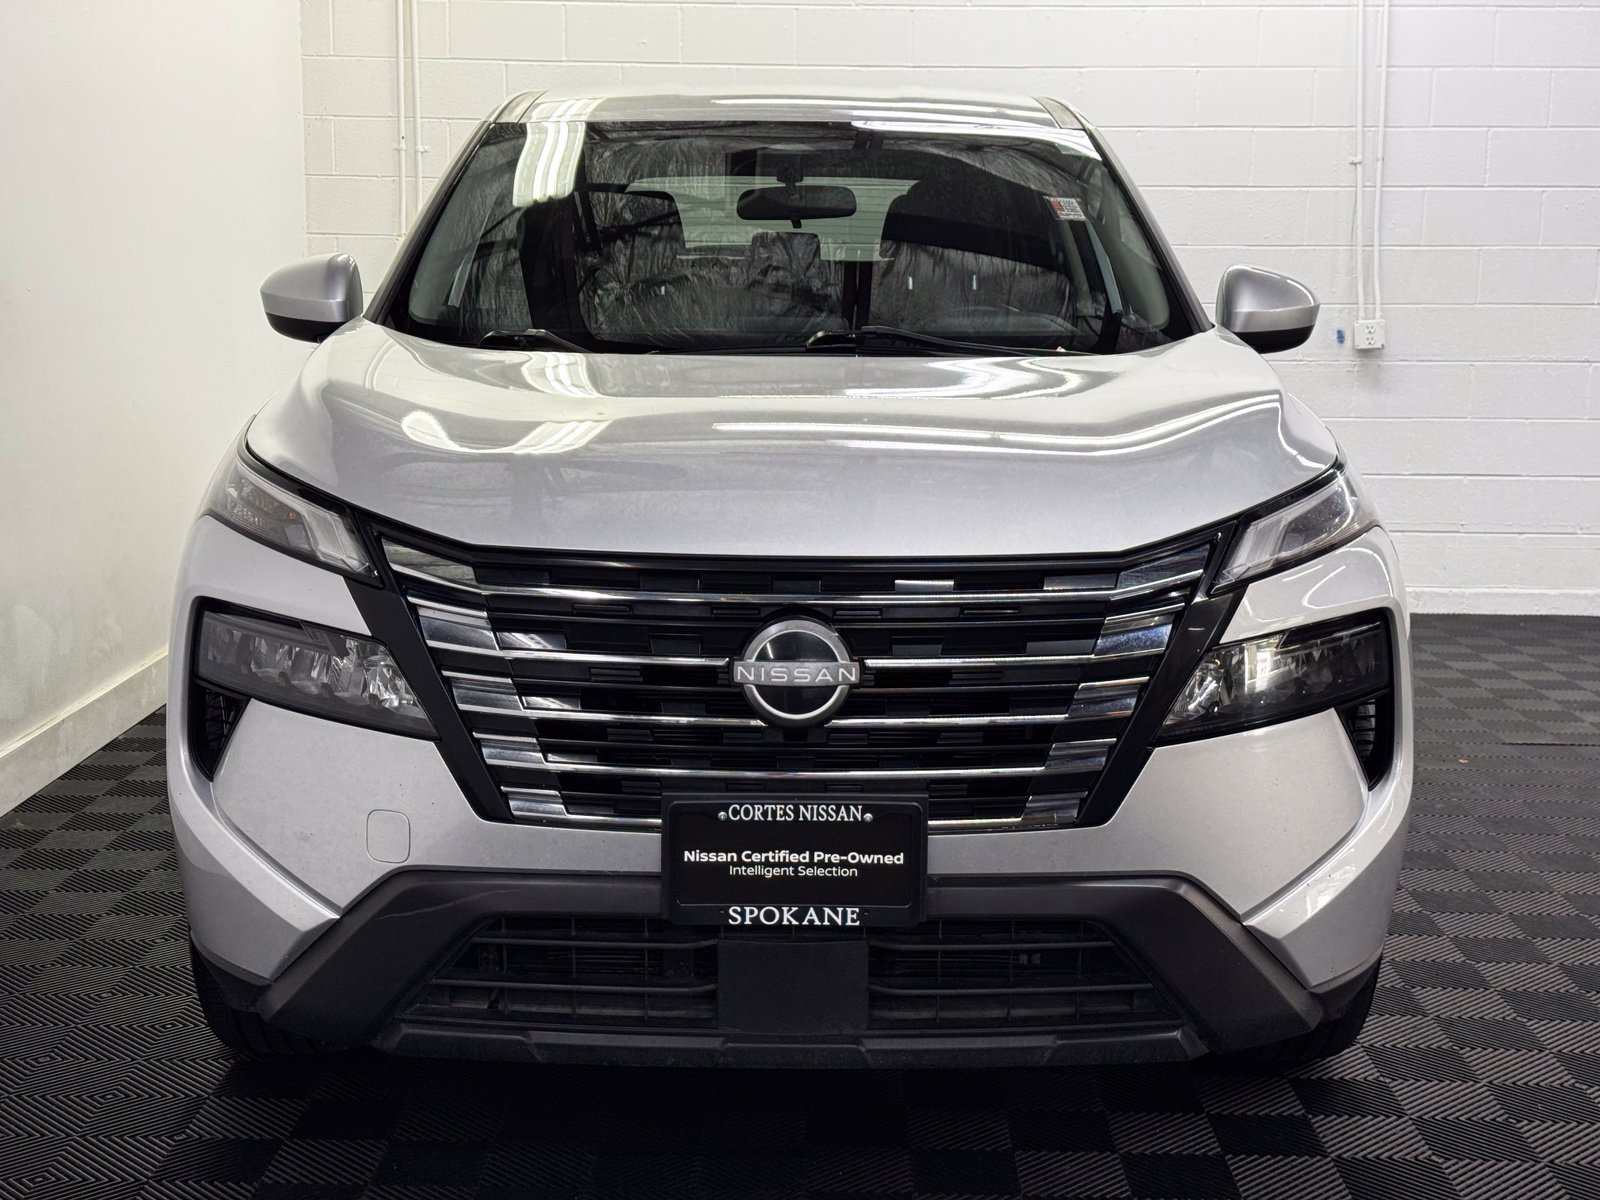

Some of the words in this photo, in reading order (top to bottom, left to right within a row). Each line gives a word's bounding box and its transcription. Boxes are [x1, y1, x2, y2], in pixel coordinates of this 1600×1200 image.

[737, 666, 856, 682] NISSAN
[728, 804, 794, 822] CORTES
[799, 804, 863, 822] NISSAN
[684, 850, 737, 862] Nissan
[741, 850, 810, 863] Certified
[814, 851, 904, 865] Pre-Owned
[729, 865, 795, 878] Intelligent
[798, 865, 858, 877] Selection
[728, 906, 860, 926] SPOKANE
